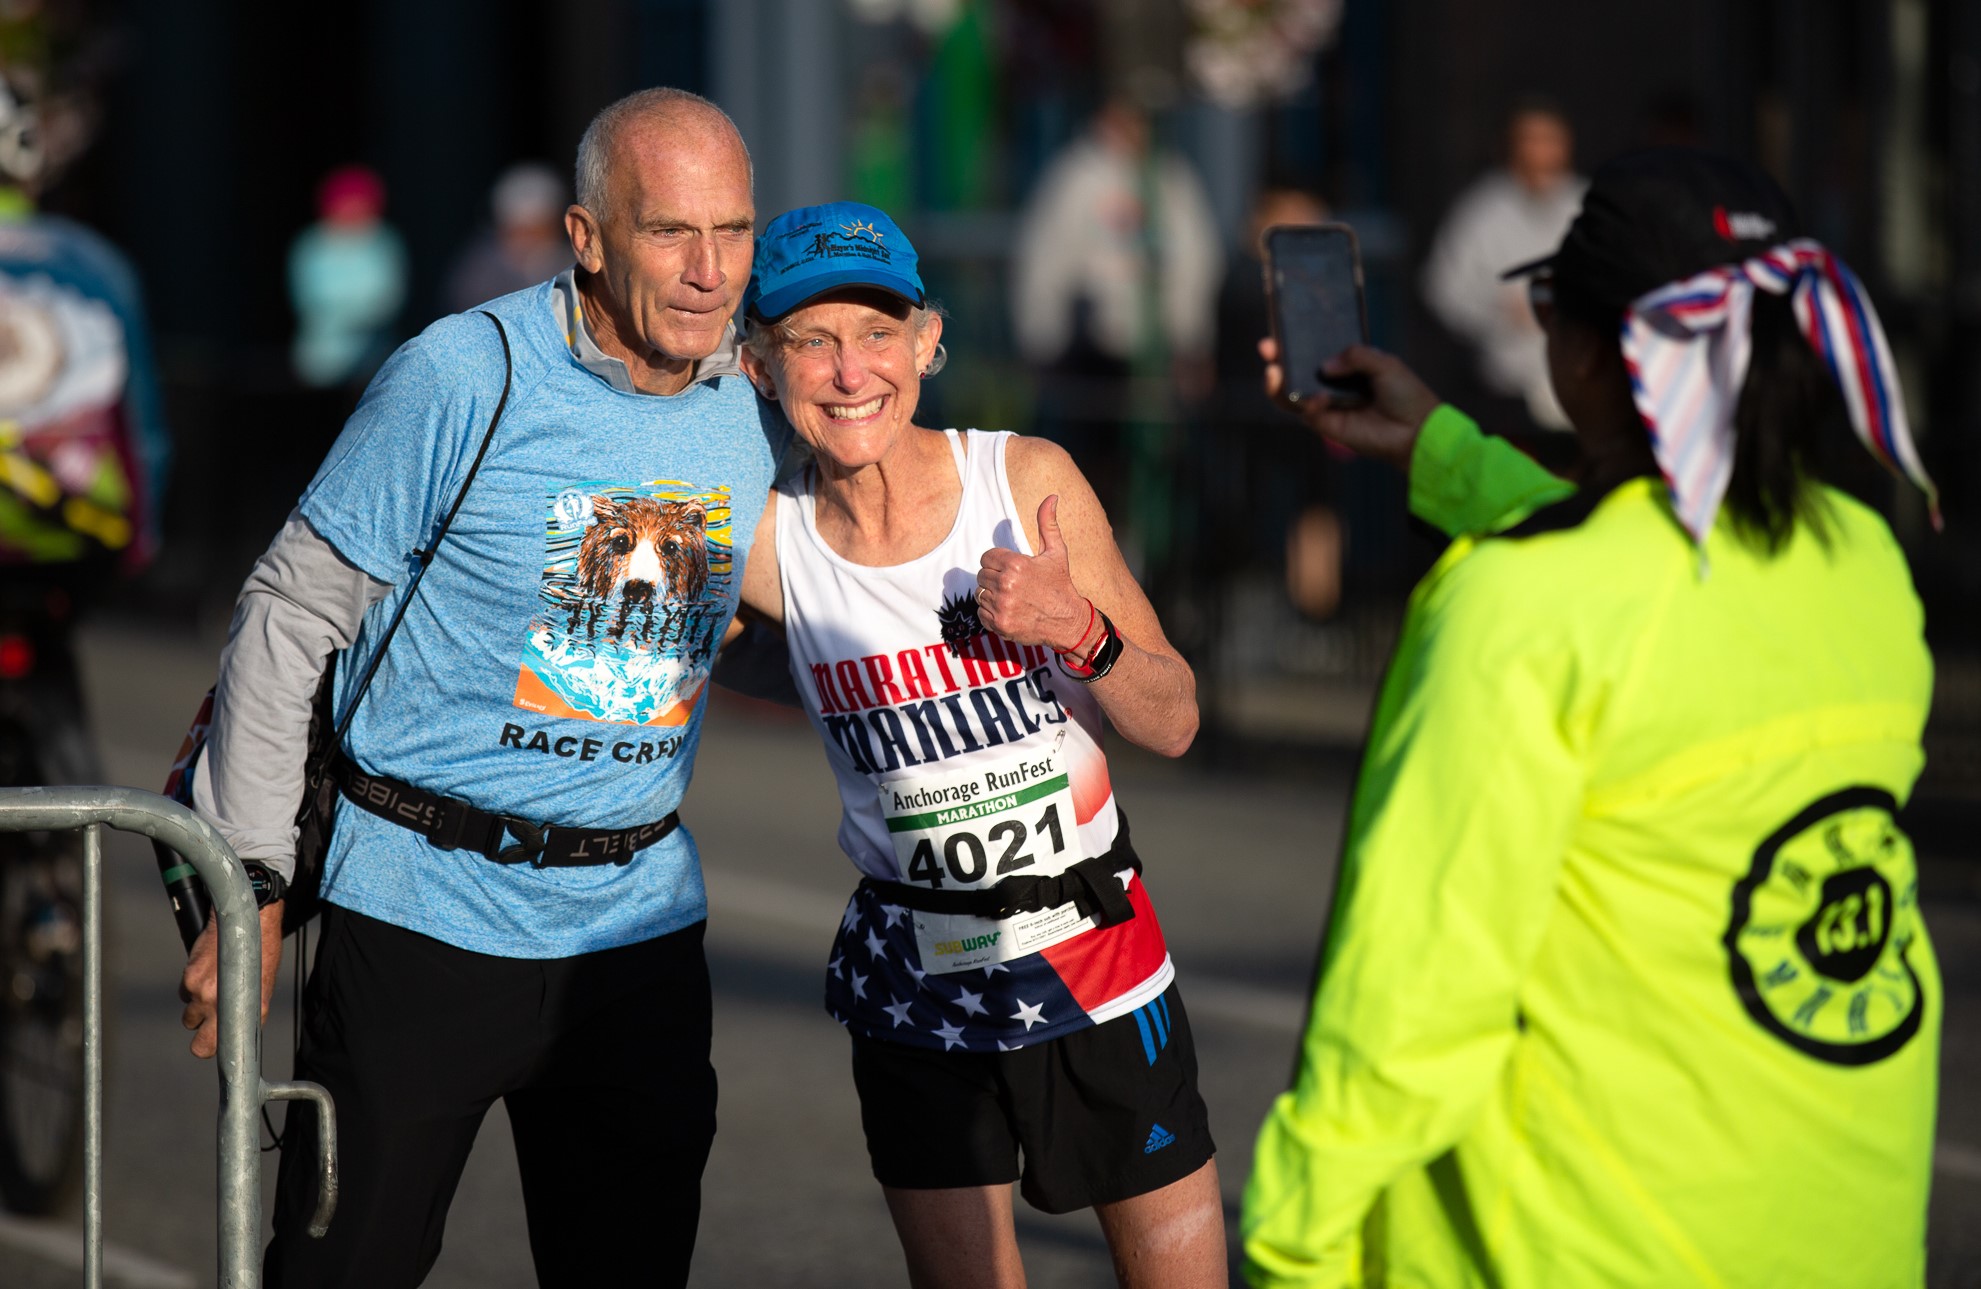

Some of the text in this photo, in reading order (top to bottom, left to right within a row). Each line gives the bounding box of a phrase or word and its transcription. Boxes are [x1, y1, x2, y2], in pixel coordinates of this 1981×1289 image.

[823, 666, 1067, 775] MANIACS
[499, 722, 604, 762] RACE
[893, 756, 1054, 811] Anchorage RunFest
[936, 794, 1018, 825] MARATHON
[908, 802, 1065, 889] 4021
[934, 931, 1001, 956] SUBWAY
[1144, 1134, 1175, 1153] adidas
